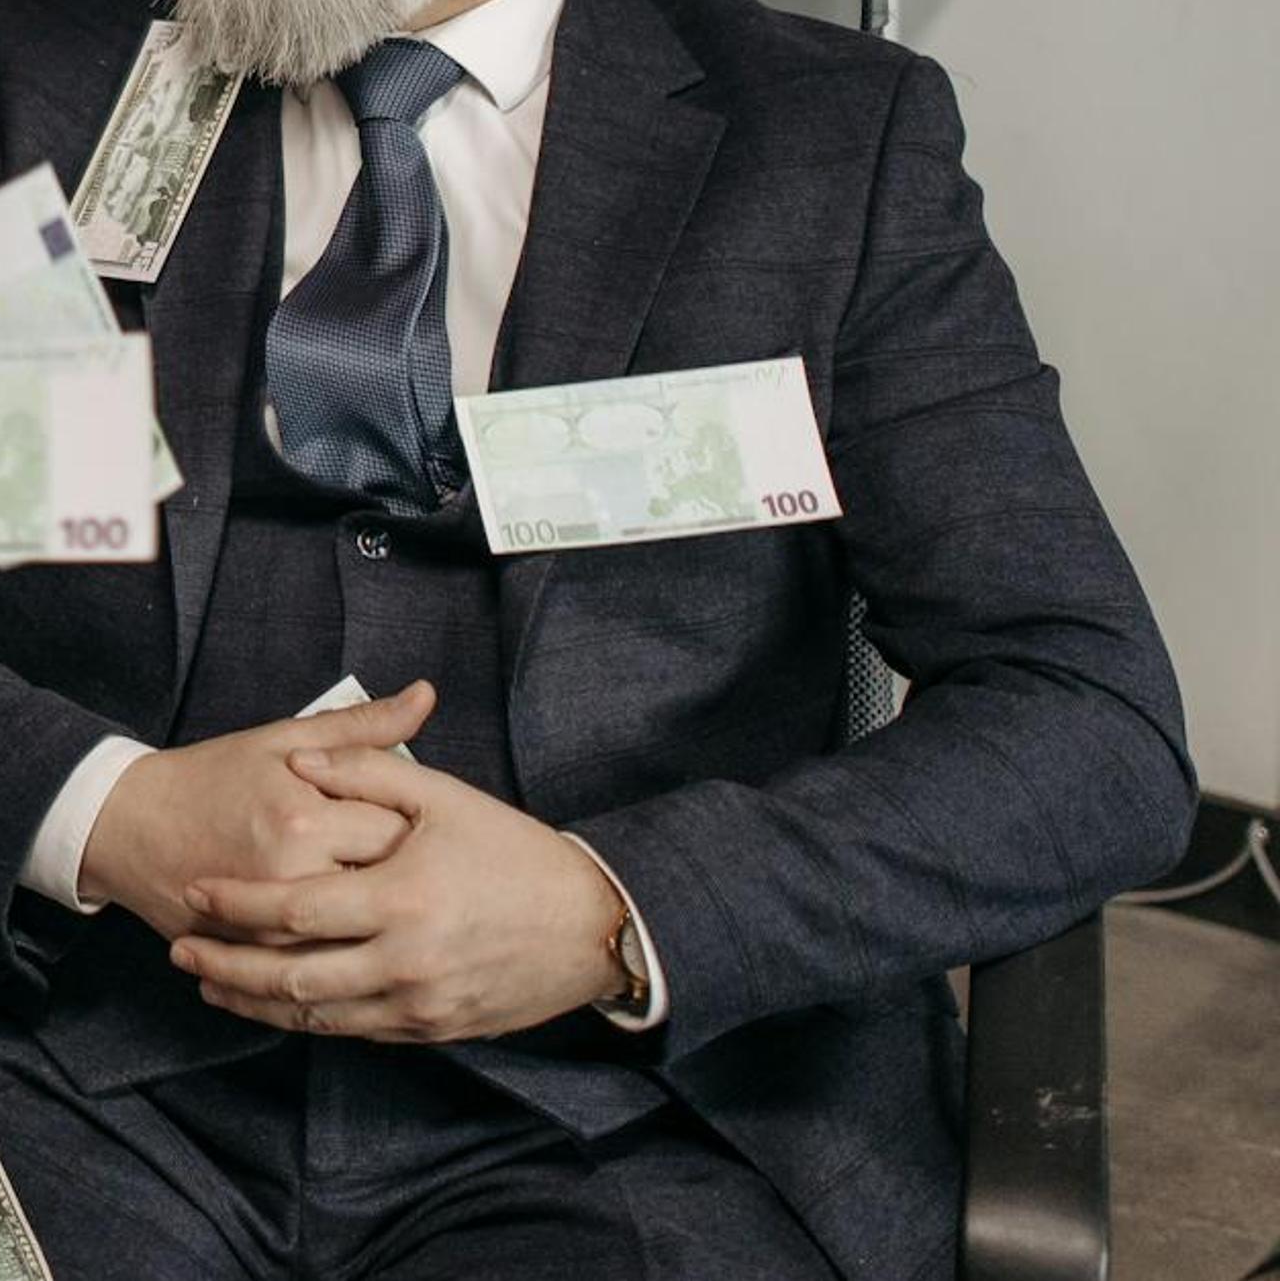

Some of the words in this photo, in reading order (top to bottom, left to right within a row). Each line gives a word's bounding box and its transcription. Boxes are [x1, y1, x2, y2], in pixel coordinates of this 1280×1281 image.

[761, 490, 820, 518] 100
[59, 517, 130, 551] 100
[500, 520, 558, 548] 100
